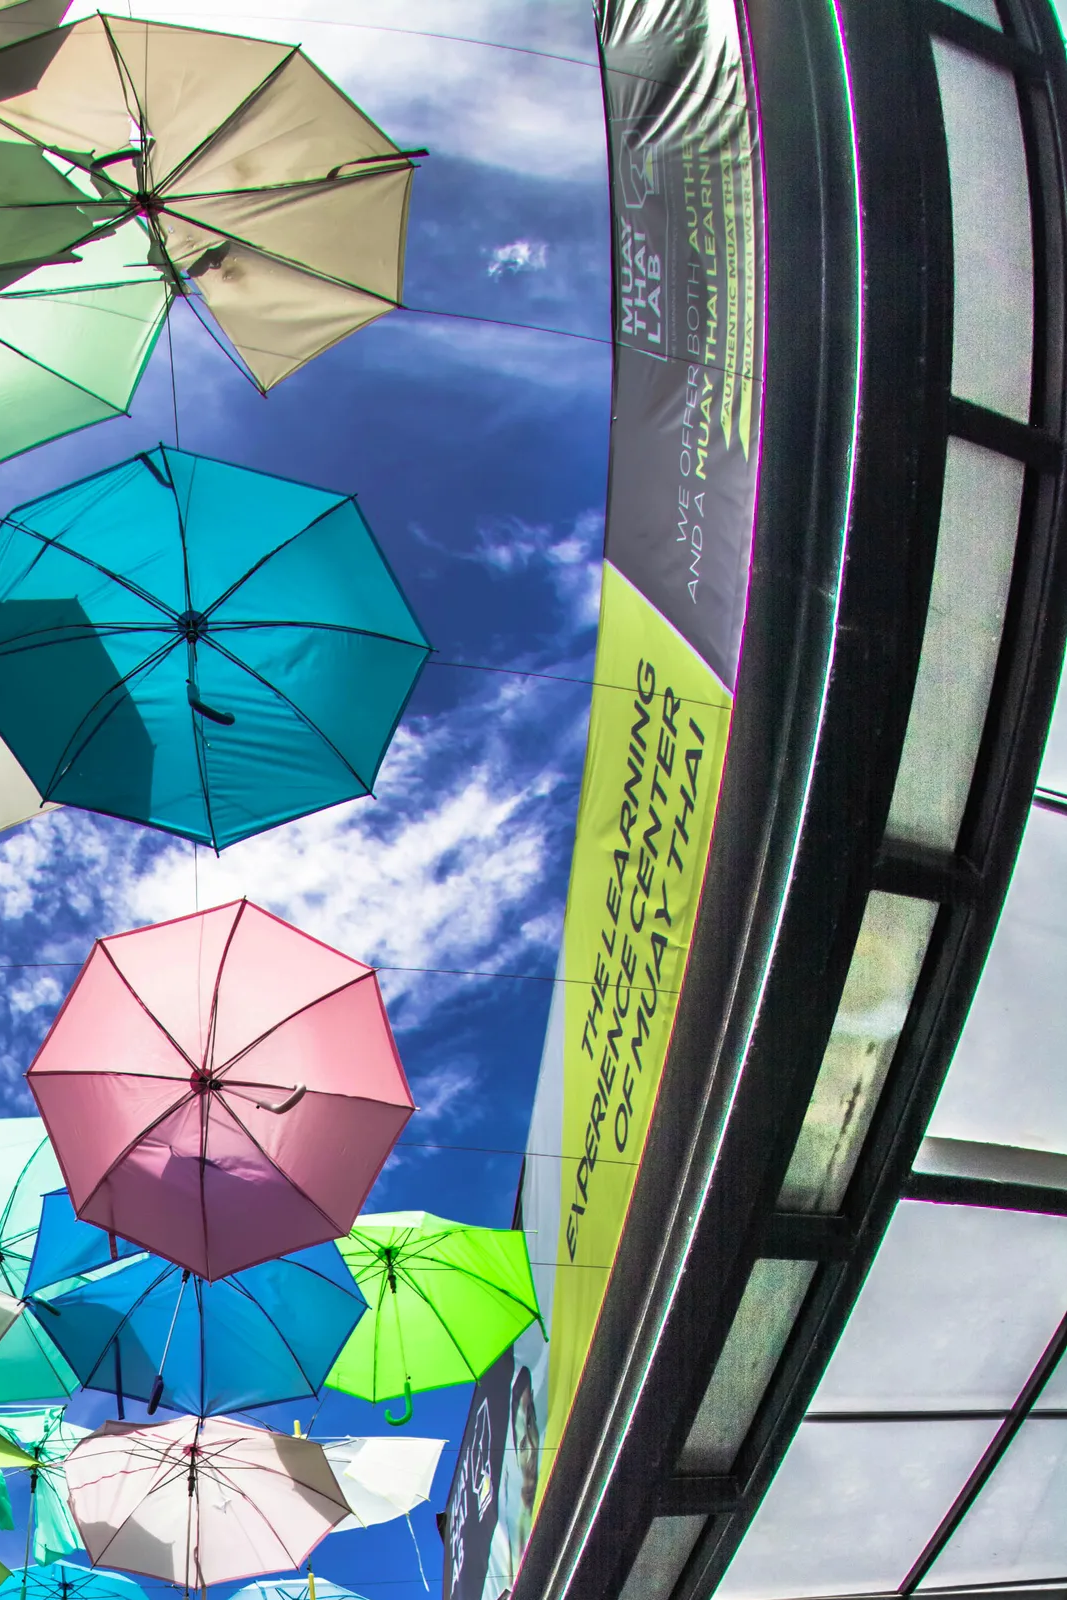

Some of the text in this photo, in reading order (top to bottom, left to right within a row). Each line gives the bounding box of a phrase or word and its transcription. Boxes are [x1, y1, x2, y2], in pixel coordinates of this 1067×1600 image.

[722, 159, 735, 208] THAI
[620, 215, 635, 335] MUAY
[633, 231, 647, 336] THAI
[725, 218, 738, 280] MUAY
[744, 251, 755, 308] THAI
[647, 253, 661, 345] LAB
[686, 261, 701, 356] BOTH
[704, 283, 719, 366] THAI
[679, 364, 700, 478] OFFER
[694, 372, 714, 481] MUAY
[676, 484, 690, 542] WE
[693, 491, 706, 518] A
[687, 524, 704, 605] AND
[581, 657, 657, 1061] THE LEARNING
[565, 685, 682, 1263] EXPERIENCE CENTER
[614, 716, 706, 1154] OF MUAY THAI
